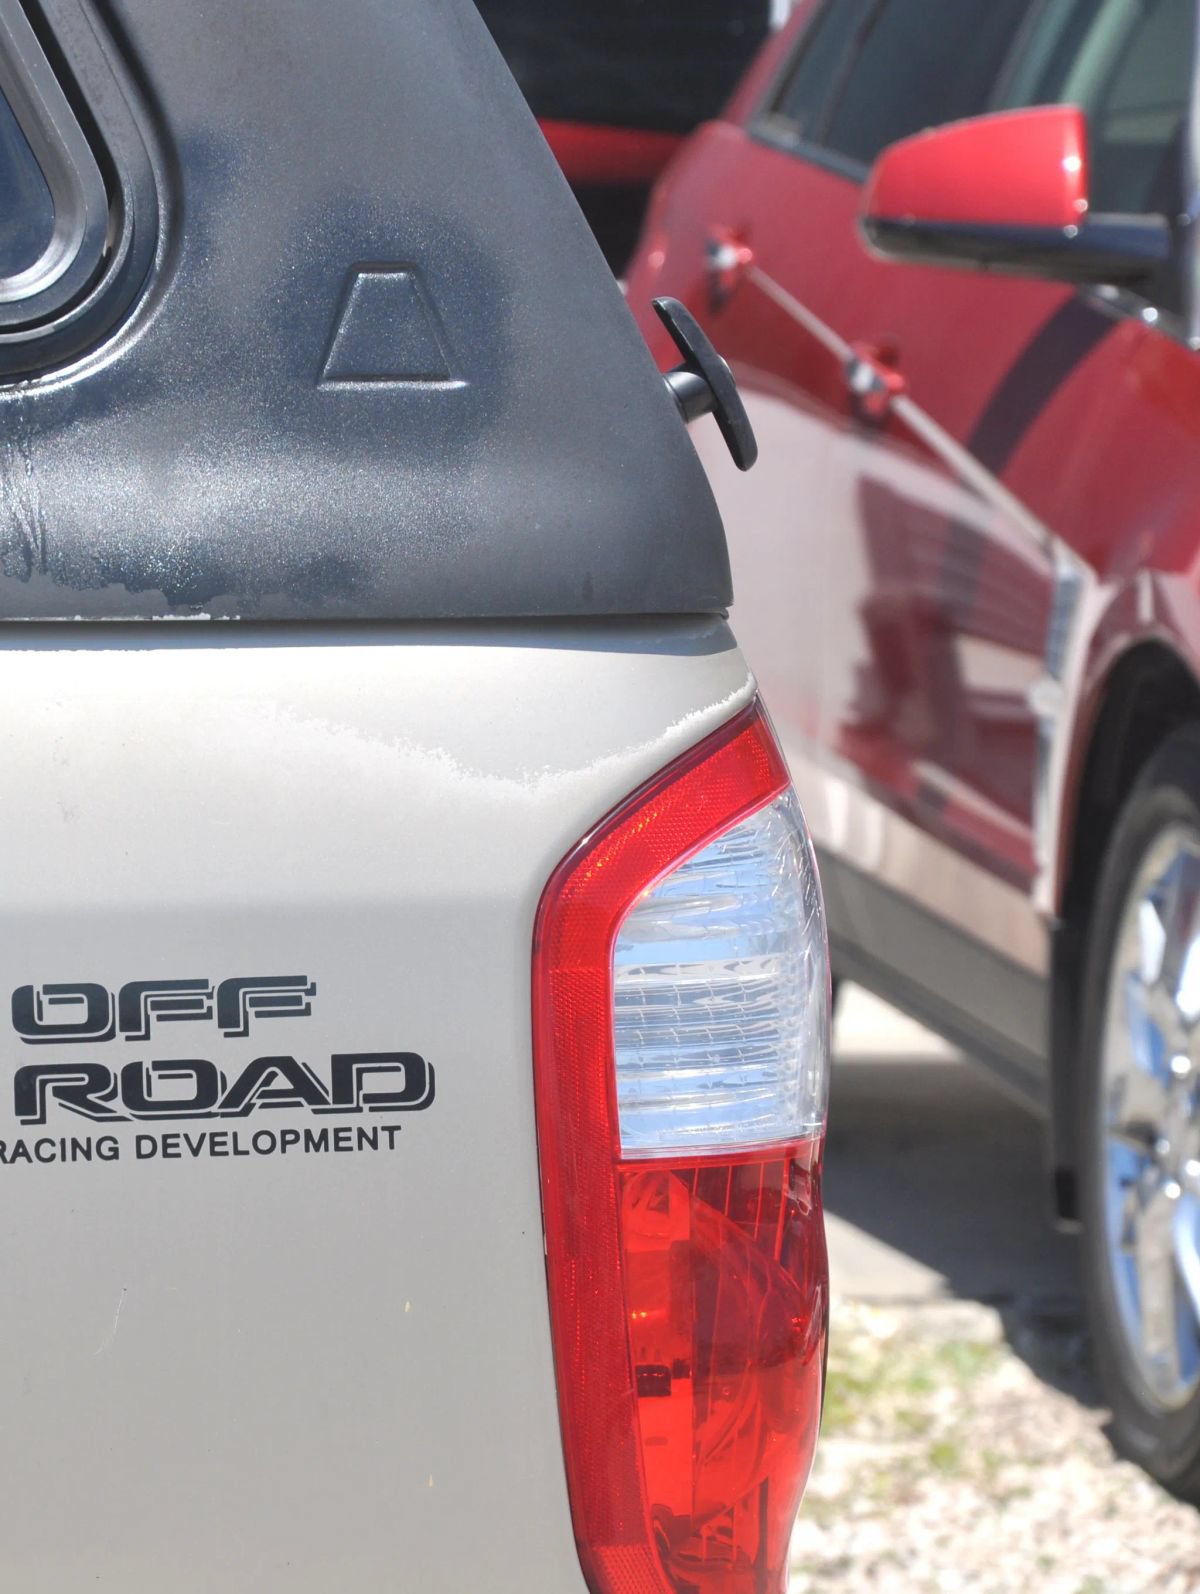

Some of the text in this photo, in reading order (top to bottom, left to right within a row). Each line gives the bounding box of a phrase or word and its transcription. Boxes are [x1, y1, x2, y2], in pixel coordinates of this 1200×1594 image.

[12, 975, 317, 1045] OFF
[14, 1052, 436, 1125] ROAD
[136, 1126, 402, 1160] DEVELOPMENT
